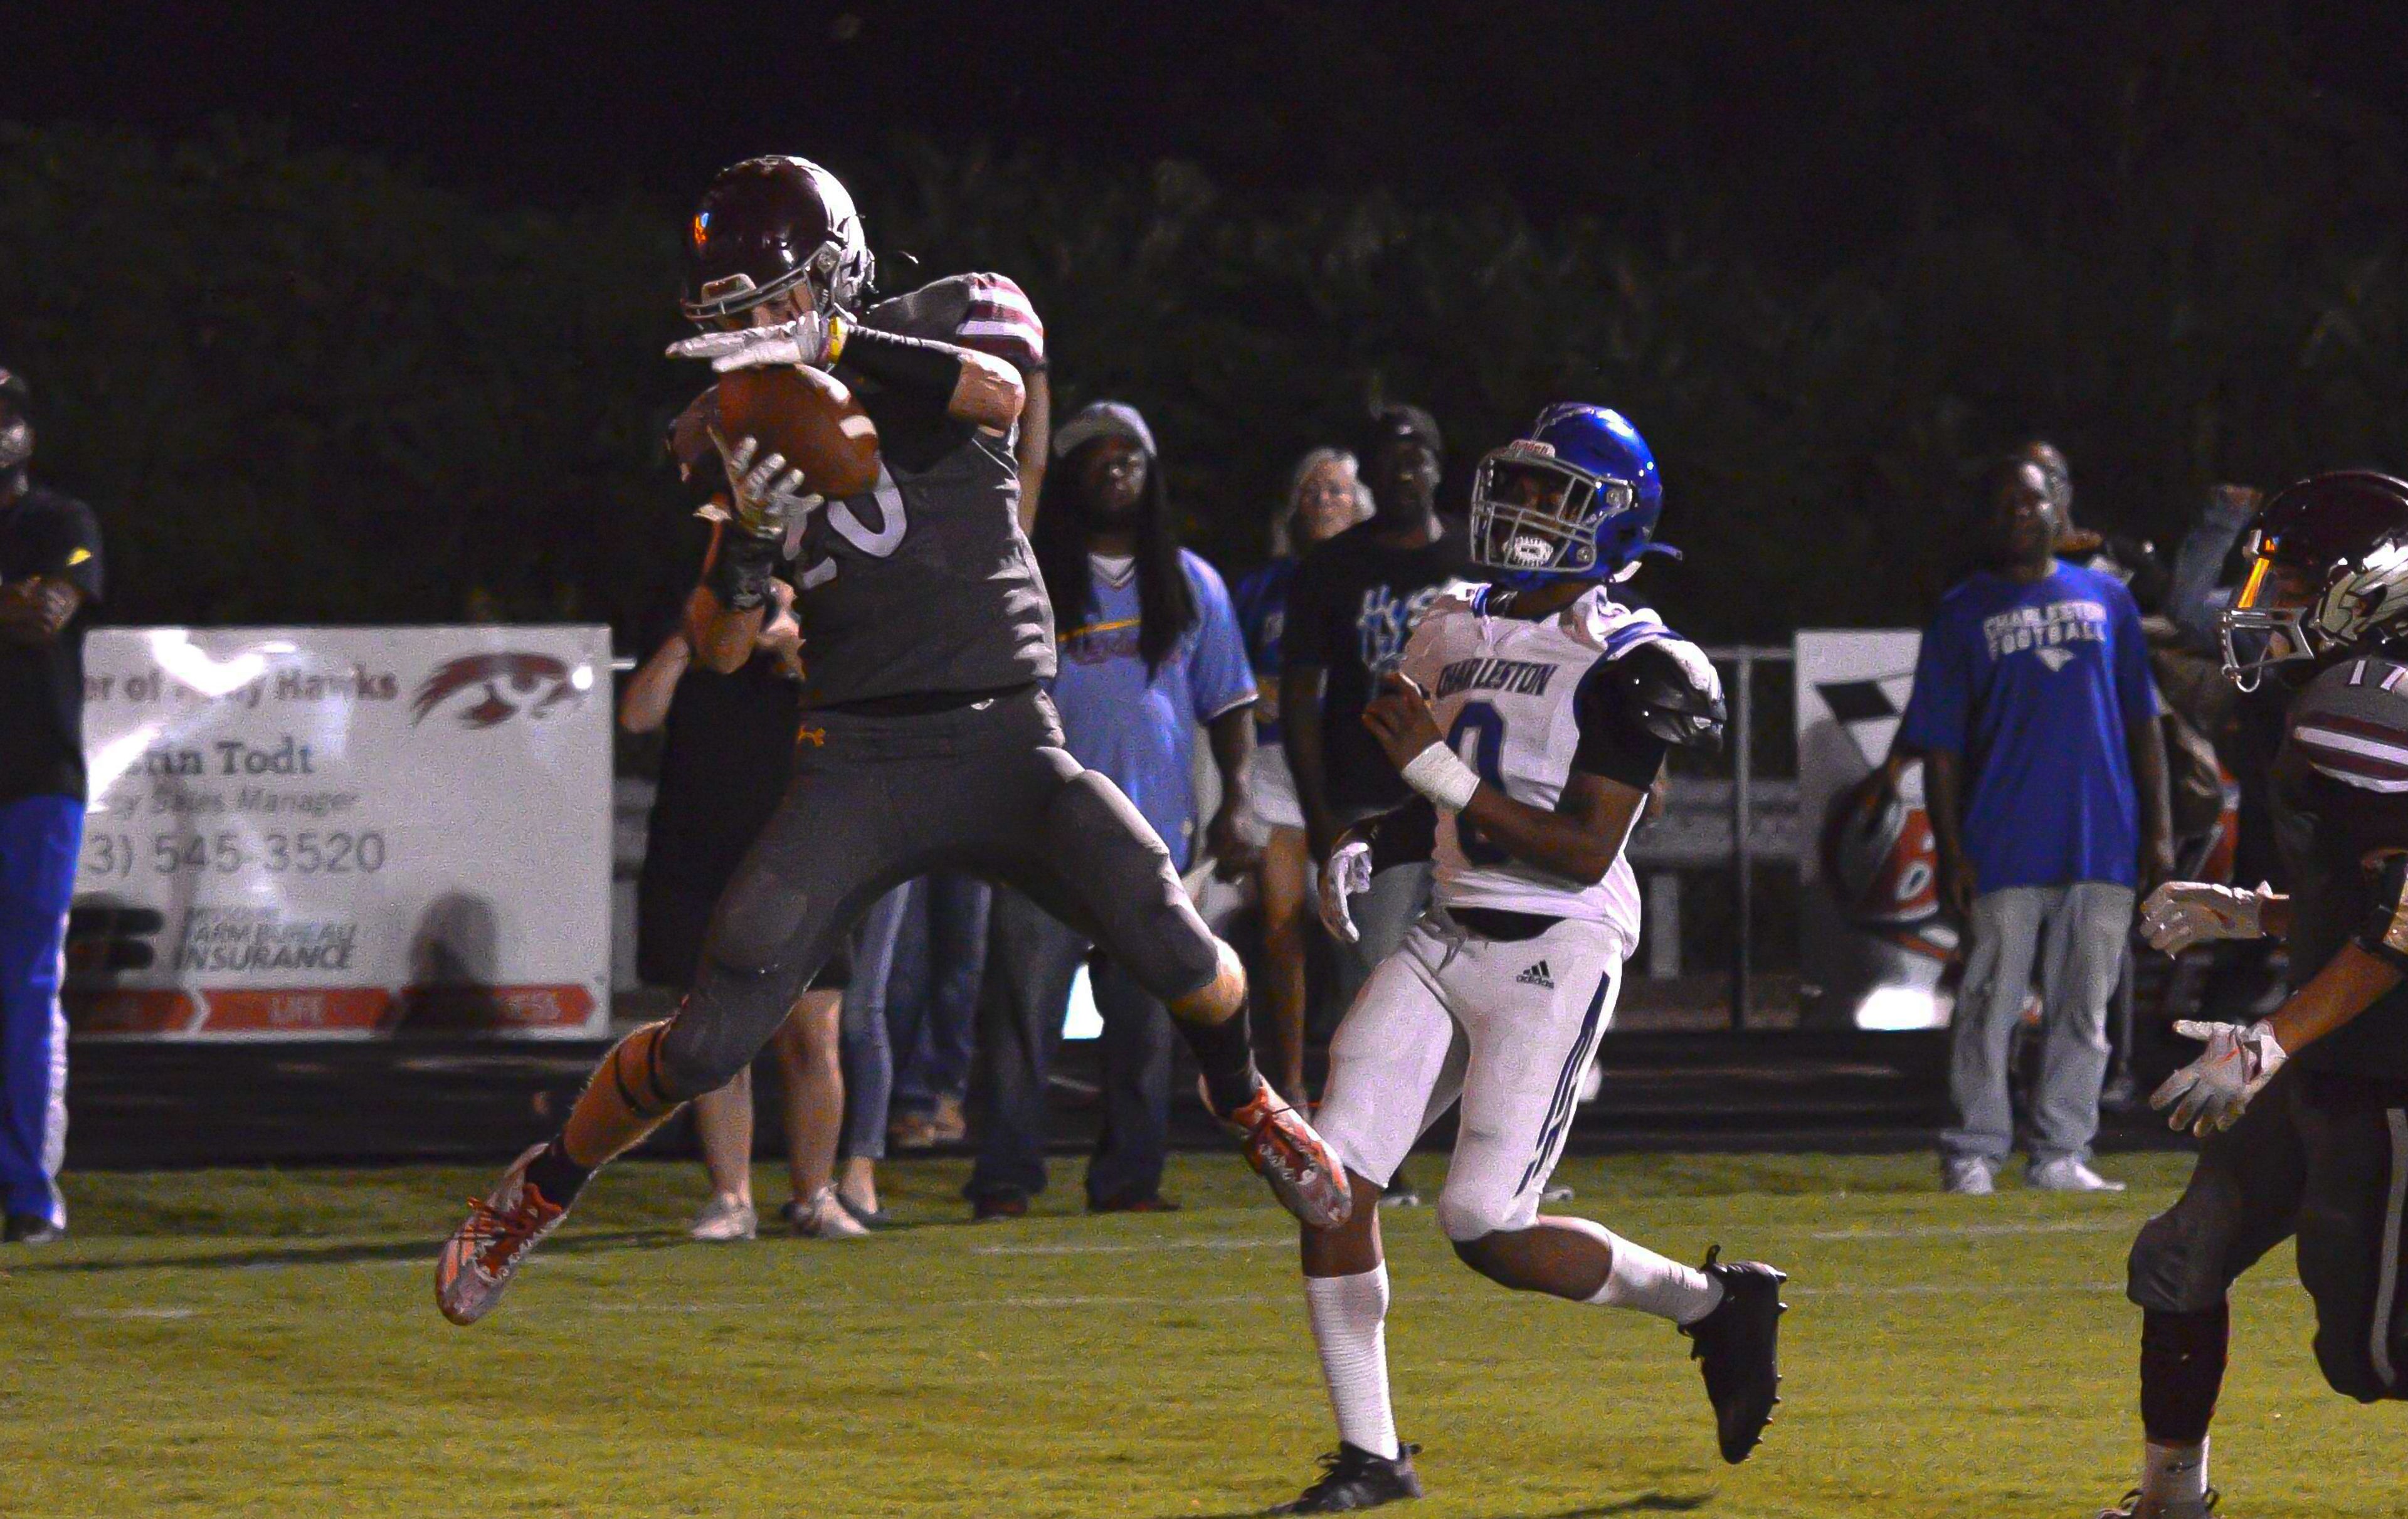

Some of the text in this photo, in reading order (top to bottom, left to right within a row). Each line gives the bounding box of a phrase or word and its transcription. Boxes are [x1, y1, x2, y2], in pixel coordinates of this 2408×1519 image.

[1985, 619, 2108, 660] FOOTBALL
[1436, 657, 1561, 699] CHARLESTON
[216, 733, 315, 775] Todt
[1516, 974, 1555, 990] adidas
